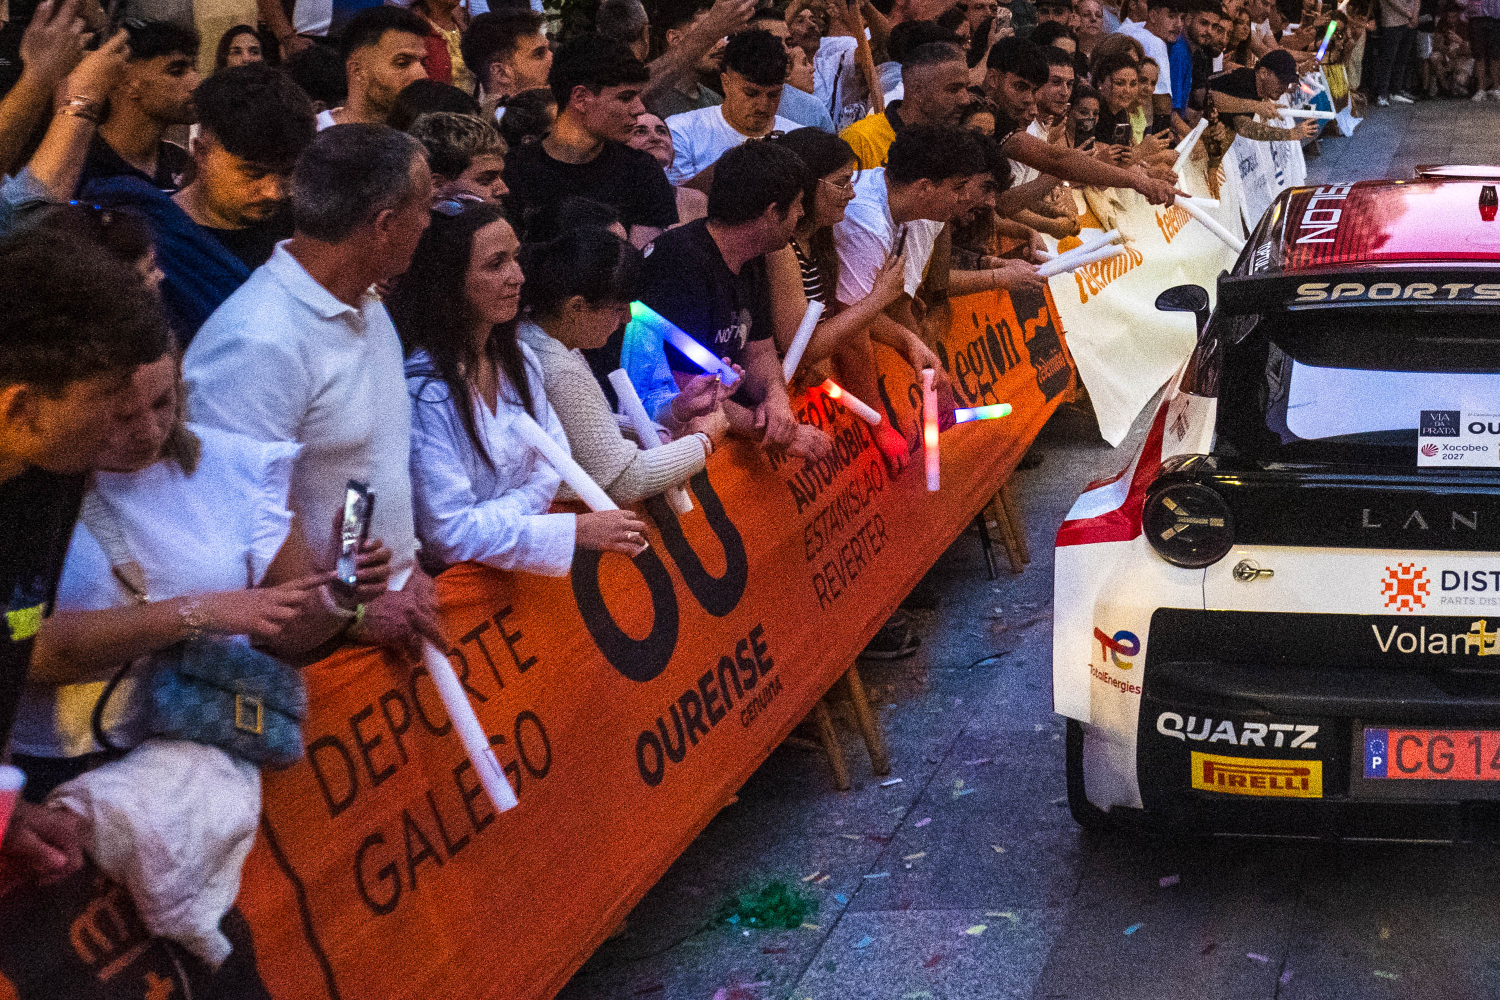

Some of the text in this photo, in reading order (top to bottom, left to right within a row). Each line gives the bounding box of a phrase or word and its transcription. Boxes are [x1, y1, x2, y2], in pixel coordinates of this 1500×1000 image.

[1422, 427, 1457, 435] PRATA
[812, 513, 891, 611] REVERTER
[1440, 596, 1476, 606] PARTS
[1088, 663, 1142, 694] TotalEnergies
[306, 604, 538, 819] DEPORTE
[1156, 711, 1320, 749] QUARTZ
[1203, 760, 1311, 791] PIRELLI
[1372, 756, 1383, 769] P
